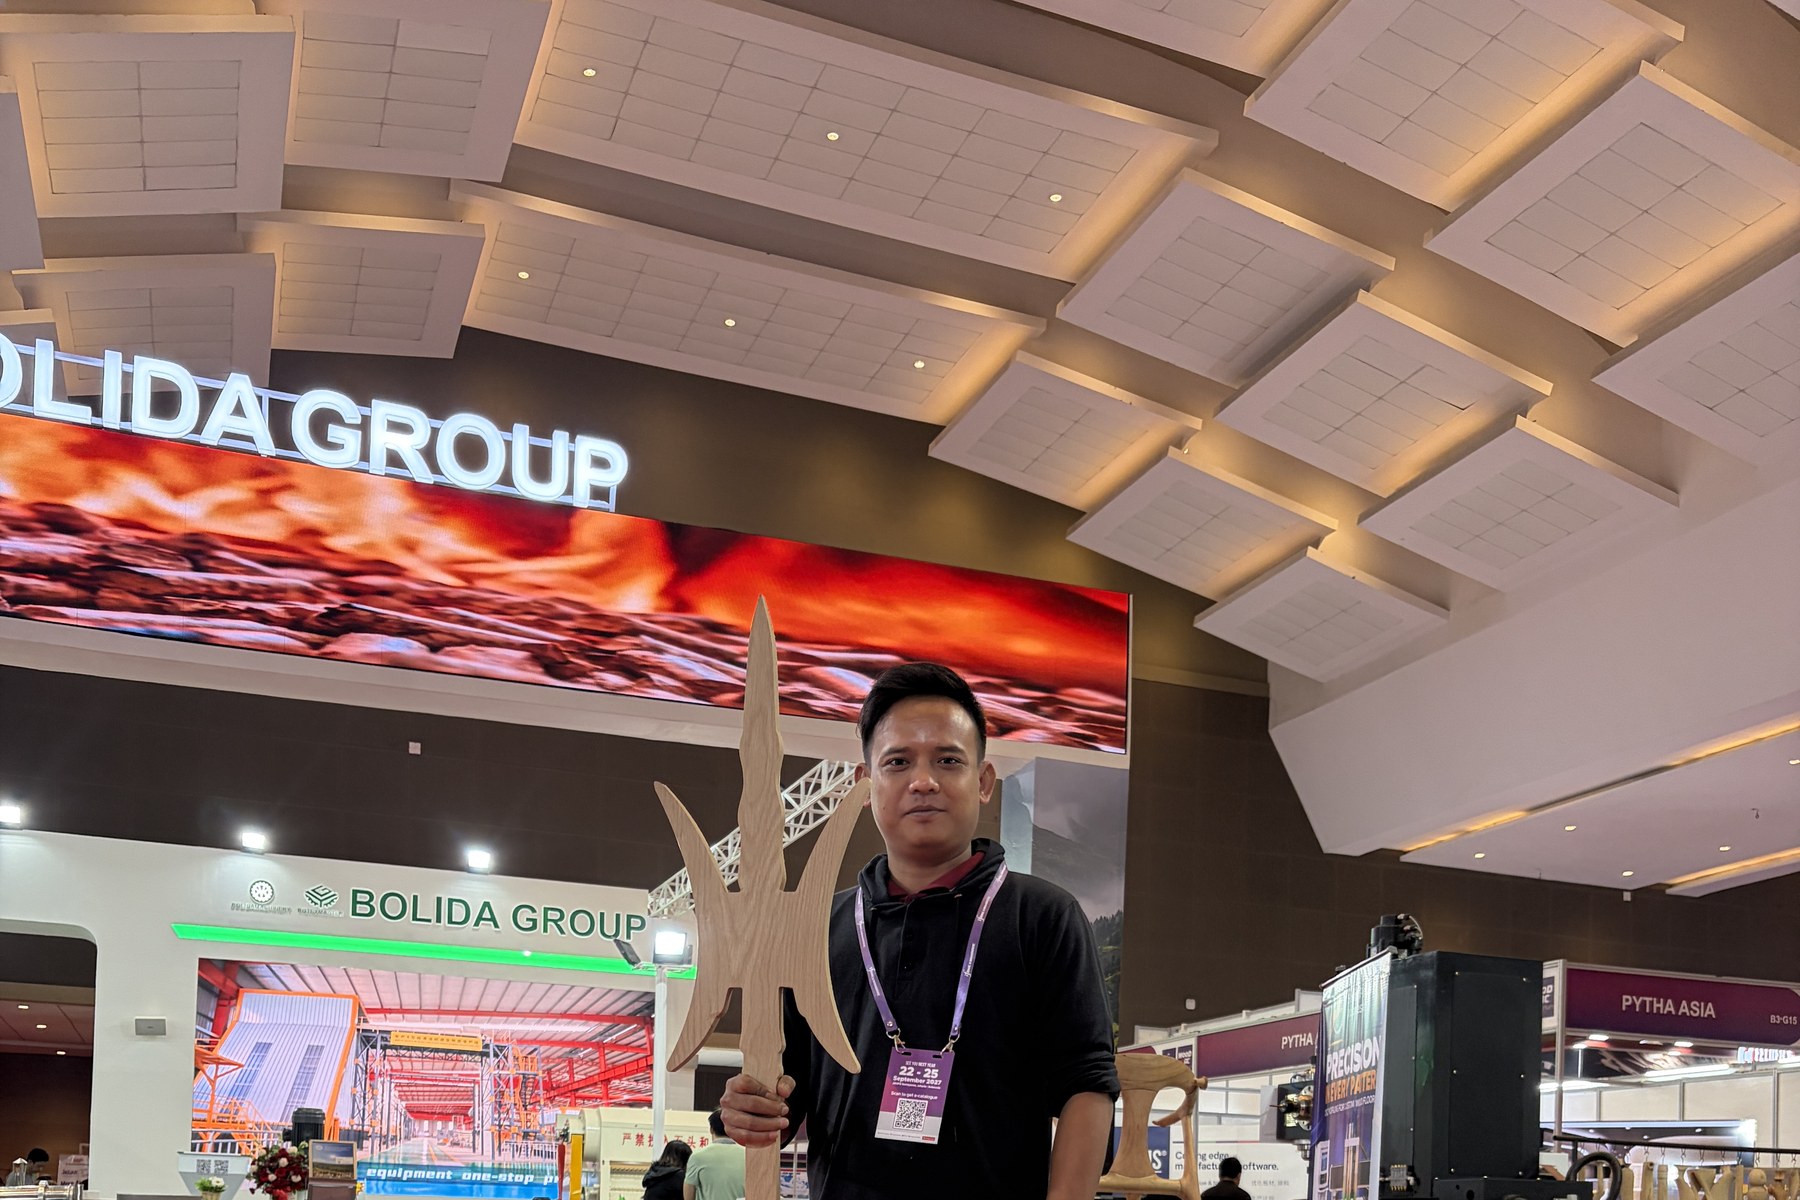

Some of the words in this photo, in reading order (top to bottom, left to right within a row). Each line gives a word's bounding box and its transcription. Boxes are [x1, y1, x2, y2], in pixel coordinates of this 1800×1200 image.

[291, 389, 629, 508] GROUP
[350, 888, 501, 930] BOLIDA
[511, 904, 647, 940] GROUP
[1622, 994, 1676, 1016] PYTHA
[1678, 1000, 1716, 1019] ASIA
[1281, 1032, 1314, 1050] PYTHA
[1325, 1034, 1382, 1083] PRECISION
[893, 1075, 925, 1085] September
[899, 1066, 915, 1077] 22
[923, 1068, 939, 1079] 25
[1242, 1161, 1279, 1171] oftware.
[366, 1167, 453, 1181] equipment
[461, 1171, 535, 1186] one-stop
